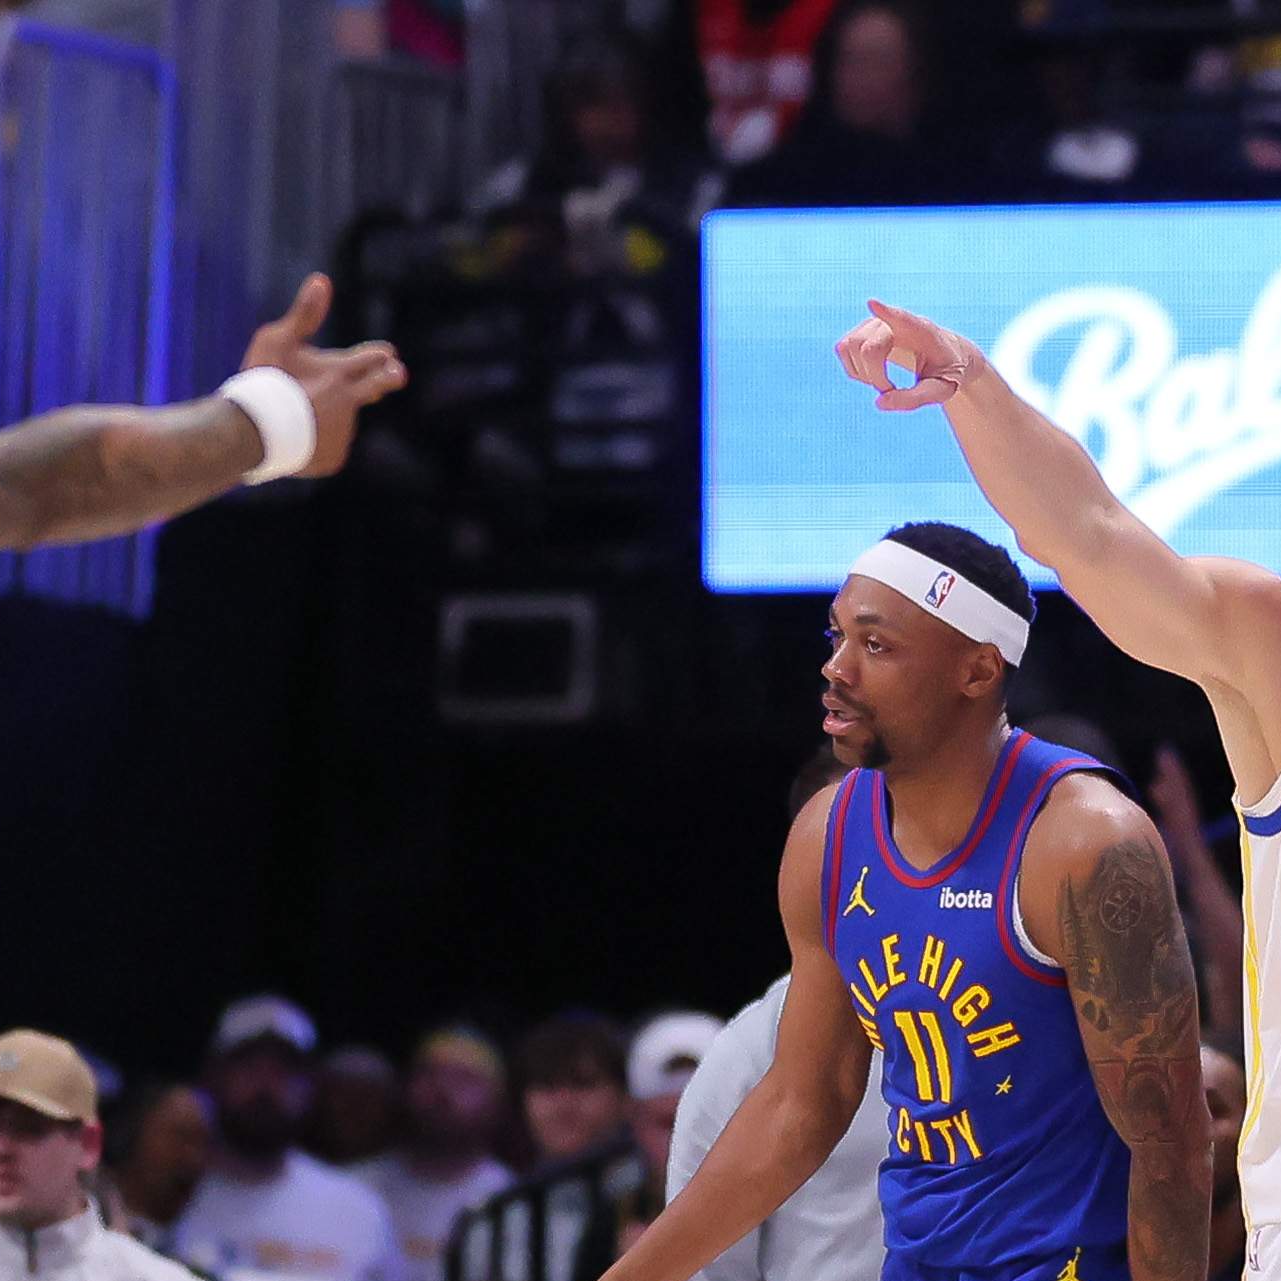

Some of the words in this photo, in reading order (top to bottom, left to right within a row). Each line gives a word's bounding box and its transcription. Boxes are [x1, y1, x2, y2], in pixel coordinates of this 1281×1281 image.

[938, 886, 994, 910] ibotta
[918, 934, 1022, 1059] HIGH
[893, 1010, 953, 1105] 11
[895, 1106, 984, 1166] CITY
